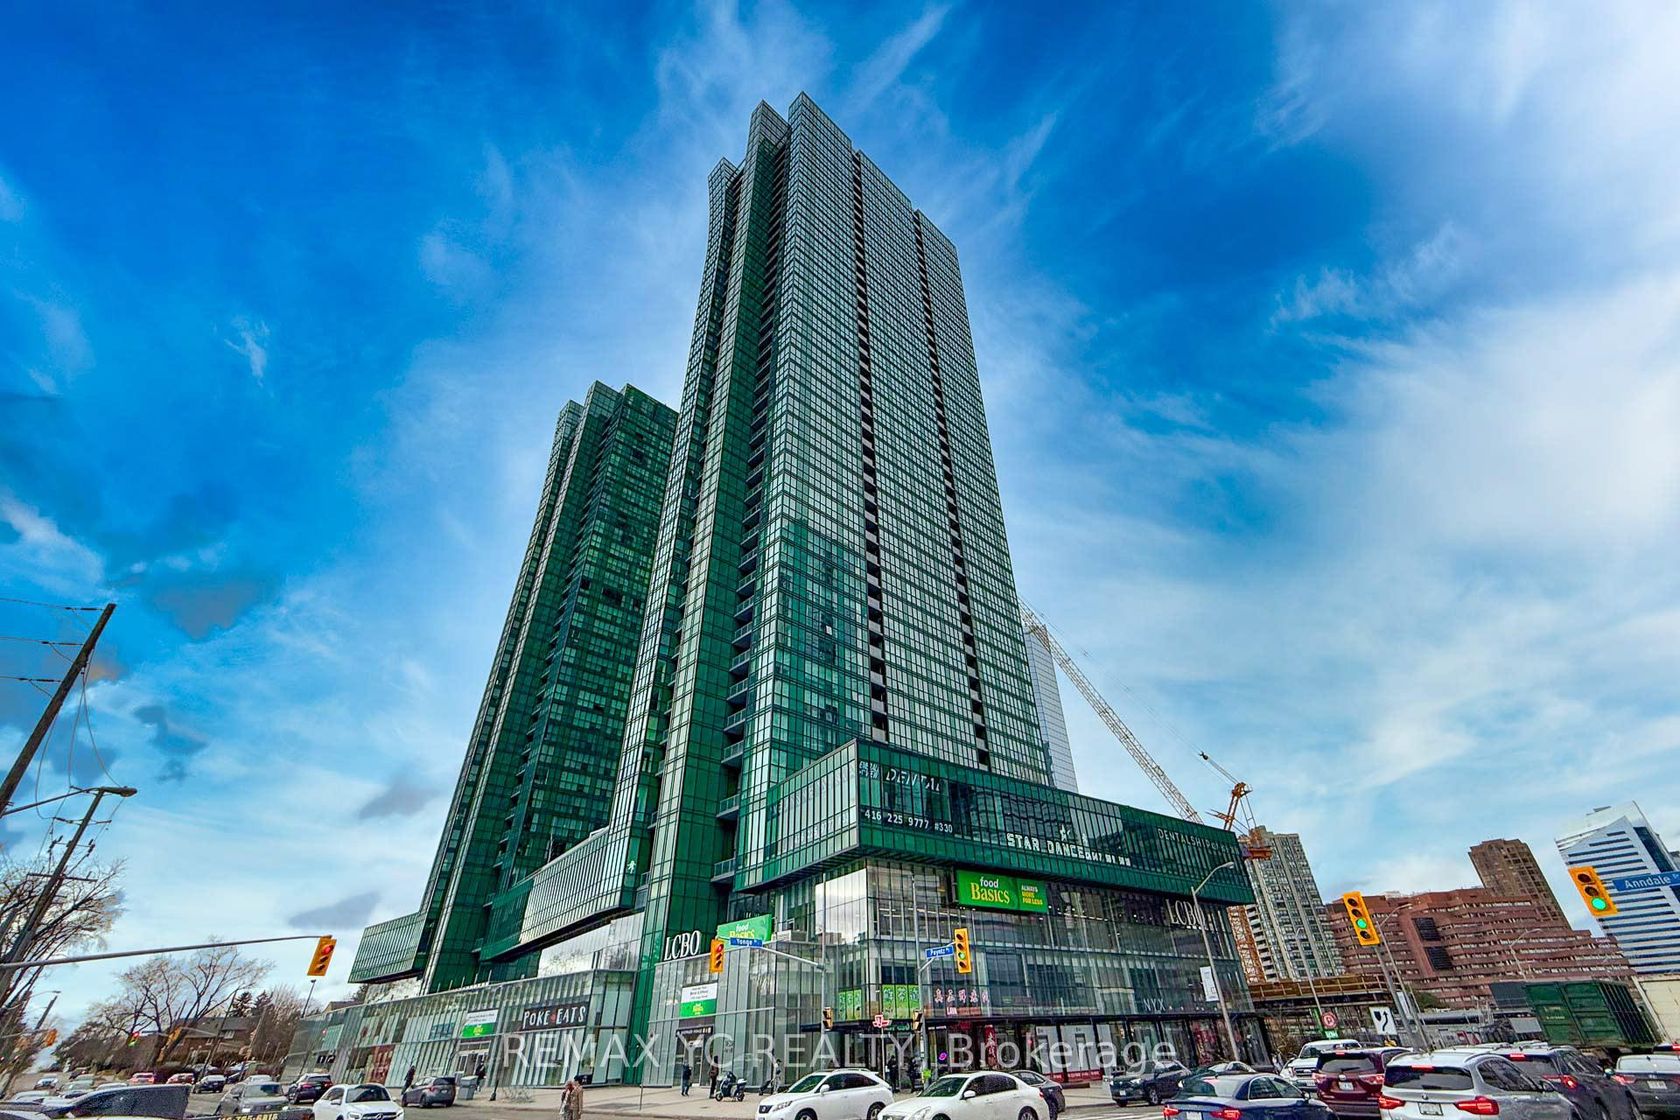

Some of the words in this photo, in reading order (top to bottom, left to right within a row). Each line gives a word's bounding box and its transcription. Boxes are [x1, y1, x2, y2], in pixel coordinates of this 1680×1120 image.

[886, 768, 941, 791] DENTAL
[864, 809, 882, 820] 416
[887, 812, 903, 824] 225
[908, 816, 929, 829] 9777
[934, 822, 953, 834] #330
[1006, 832, 1040, 851] STAR
[980, 876, 999, 888] food
[1625, 875, 1671, 889] Anndale
[664, 930, 701, 961] LCBO
[522, 1009, 550, 1030] POKE
[556, 1005, 586, 1025] EATS
